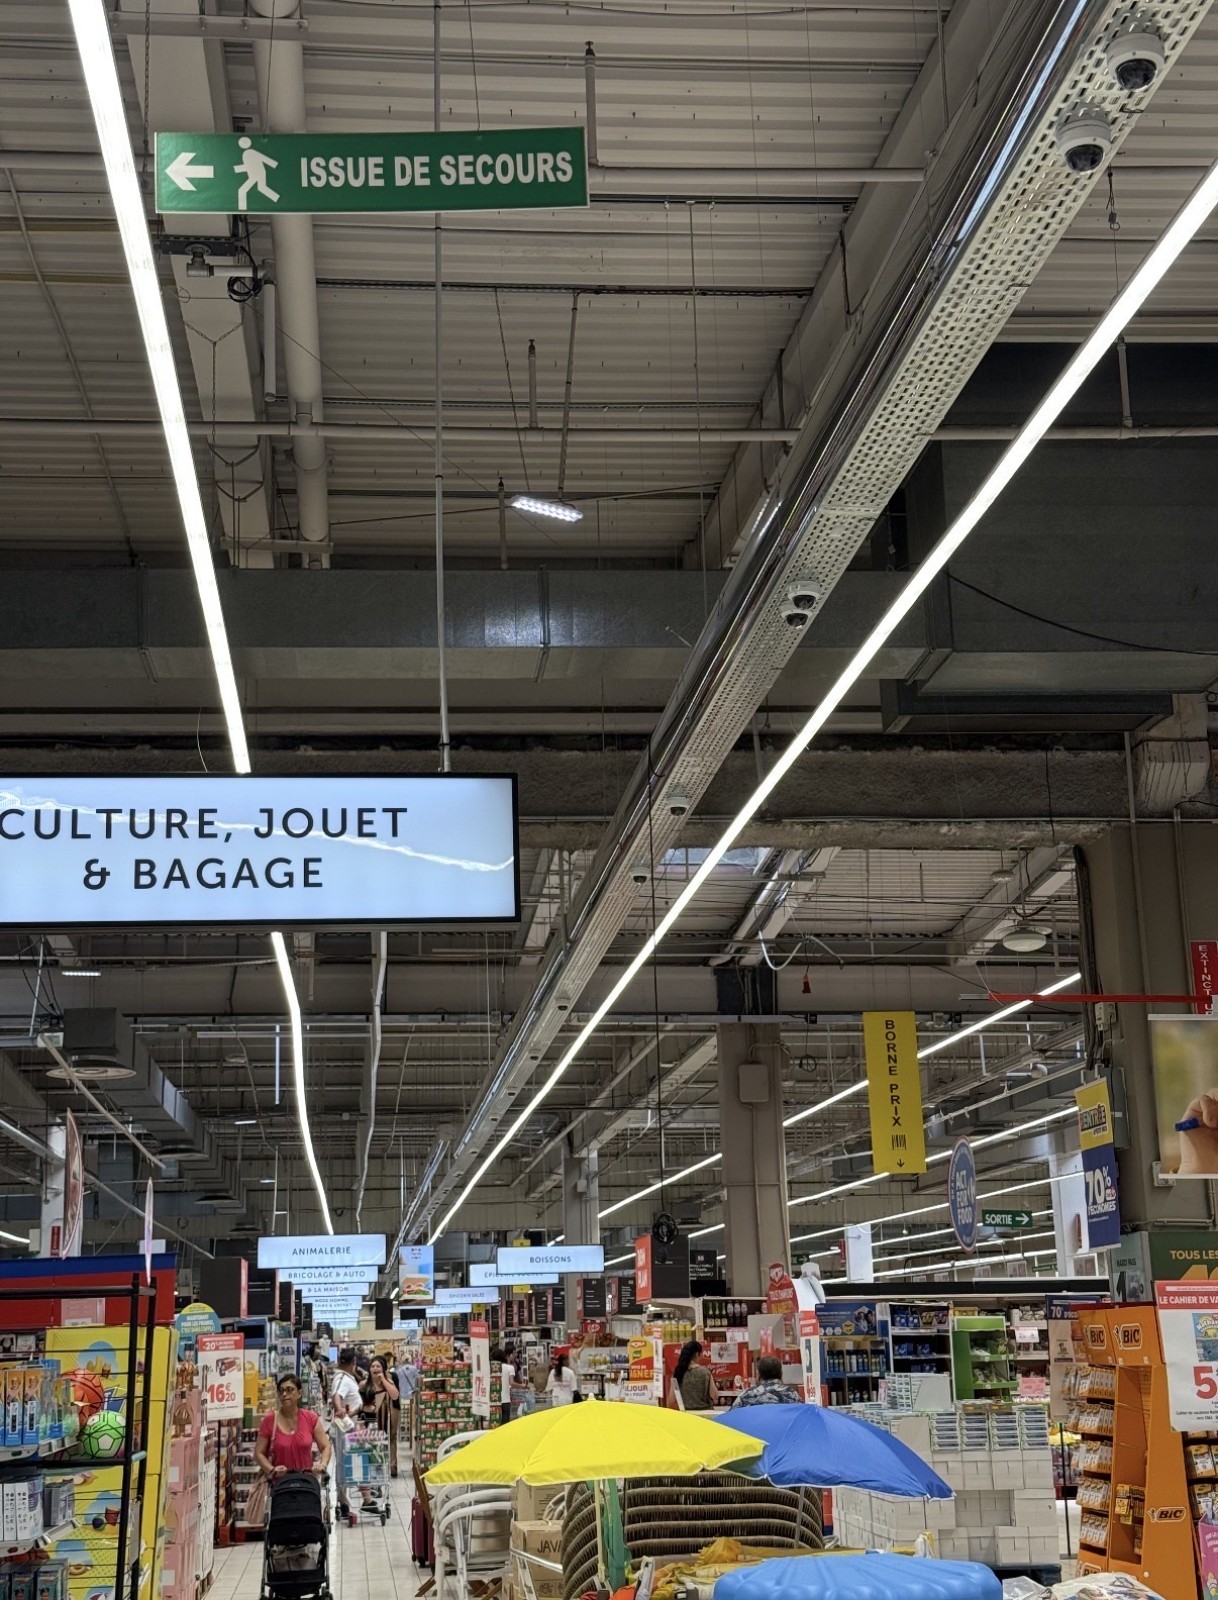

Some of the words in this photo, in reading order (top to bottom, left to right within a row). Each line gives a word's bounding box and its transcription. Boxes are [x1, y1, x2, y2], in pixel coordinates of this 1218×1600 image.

[300, 156, 385, 187] ISSUE
[394, 155, 431, 186] DE
[439, 151, 574, 186] SECOURS
[0, 807, 232, 843] CULTURE,
[254, 807, 408, 839] JOUET
[83, 858, 111, 891] &
[133, 857, 324, 890] BAGAGE
[885, 1019, 899, 1076] BORNE
[889, 1083, 902, 1127] PRIX
[957, 1206, 973, 1226] FOOD
[985, 1213, 1013, 1225] SORTIE
[291, 1246, 352, 1256] ANIMALERIE
[1169, 1250, 1201, 1260] TOUS
[1202, 1250, 1218, 1260] LES
[529, 1256, 572, 1264] BOISSONS
[288, 1271, 333, 1279] BRICOLAGE
[343, 1270, 366, 1278] AUTO
[1159, 1295, 1169, 1304] LE
[1169, 1295, 1197, 1305] CAHIER
[1198, 1295, 1209, 1304] DE
[1193, 1365, 1218, 1400] 5
[537, 1540, 562, 1554] JAV
